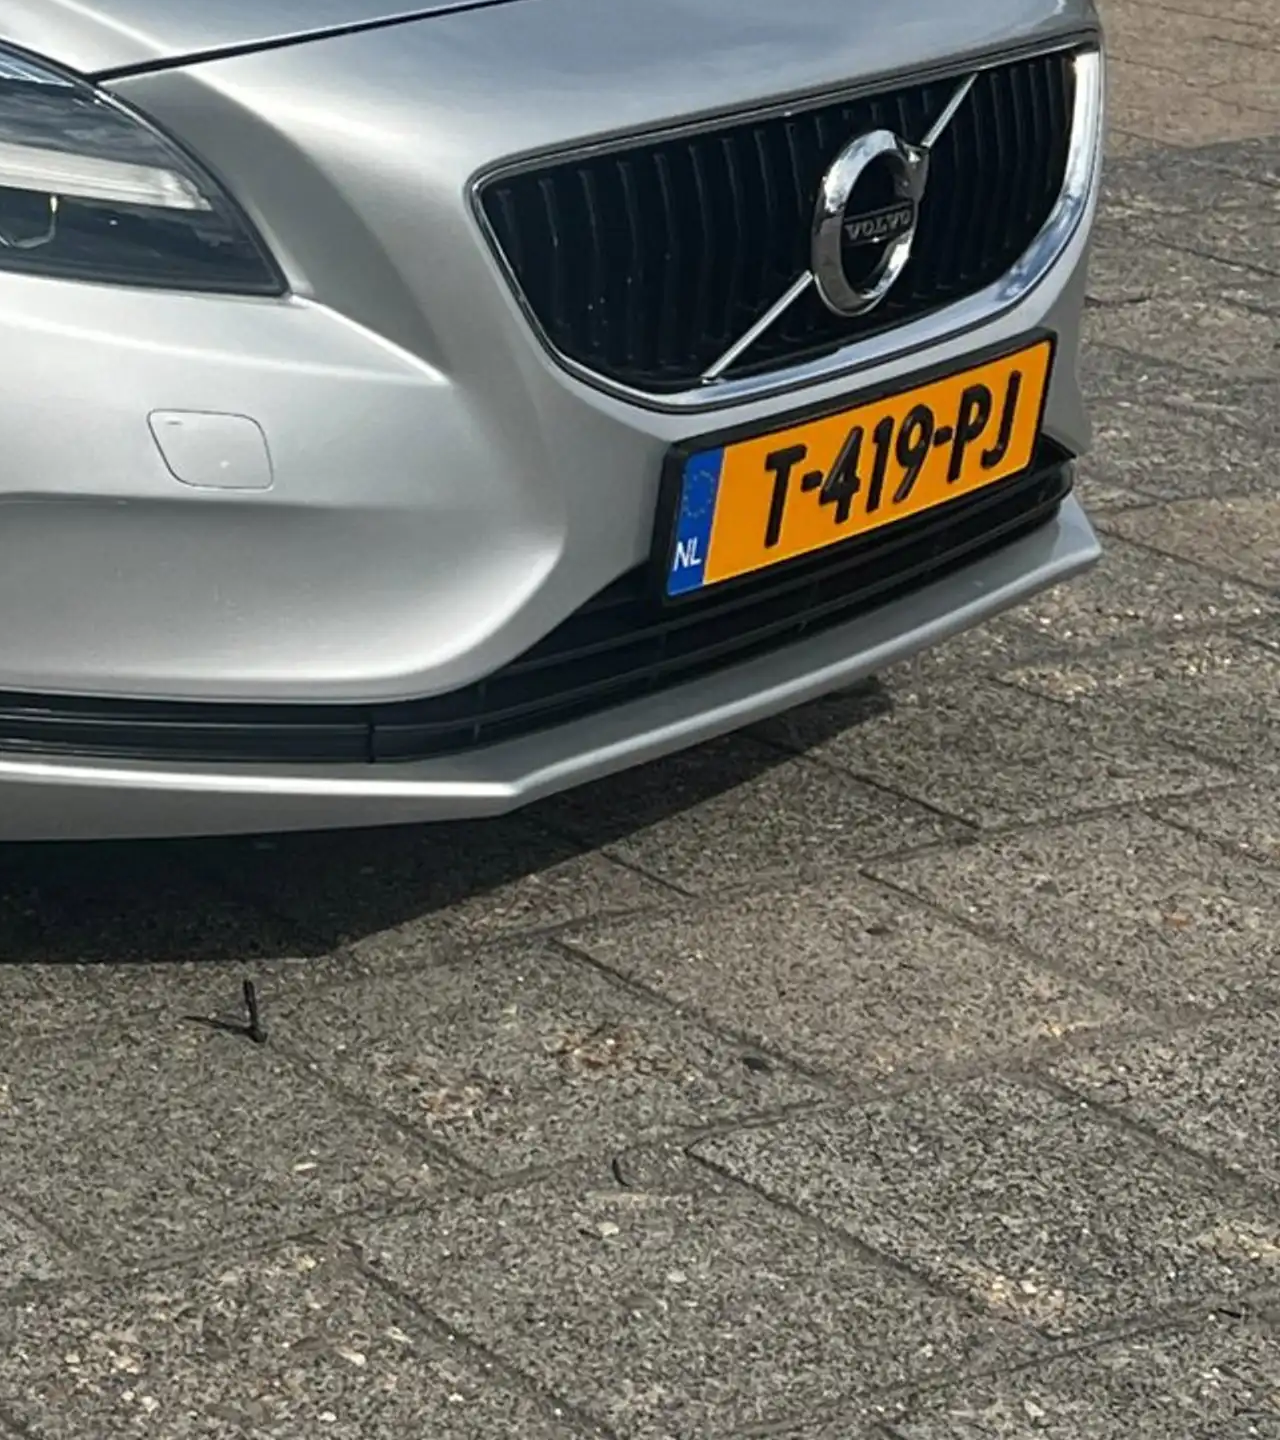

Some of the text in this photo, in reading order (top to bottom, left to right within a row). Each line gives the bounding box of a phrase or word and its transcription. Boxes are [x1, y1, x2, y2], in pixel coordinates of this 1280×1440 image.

[843, 208, 912, 241] VOLVO
[672, 369, 1023, 572] NL T-419-PJ
